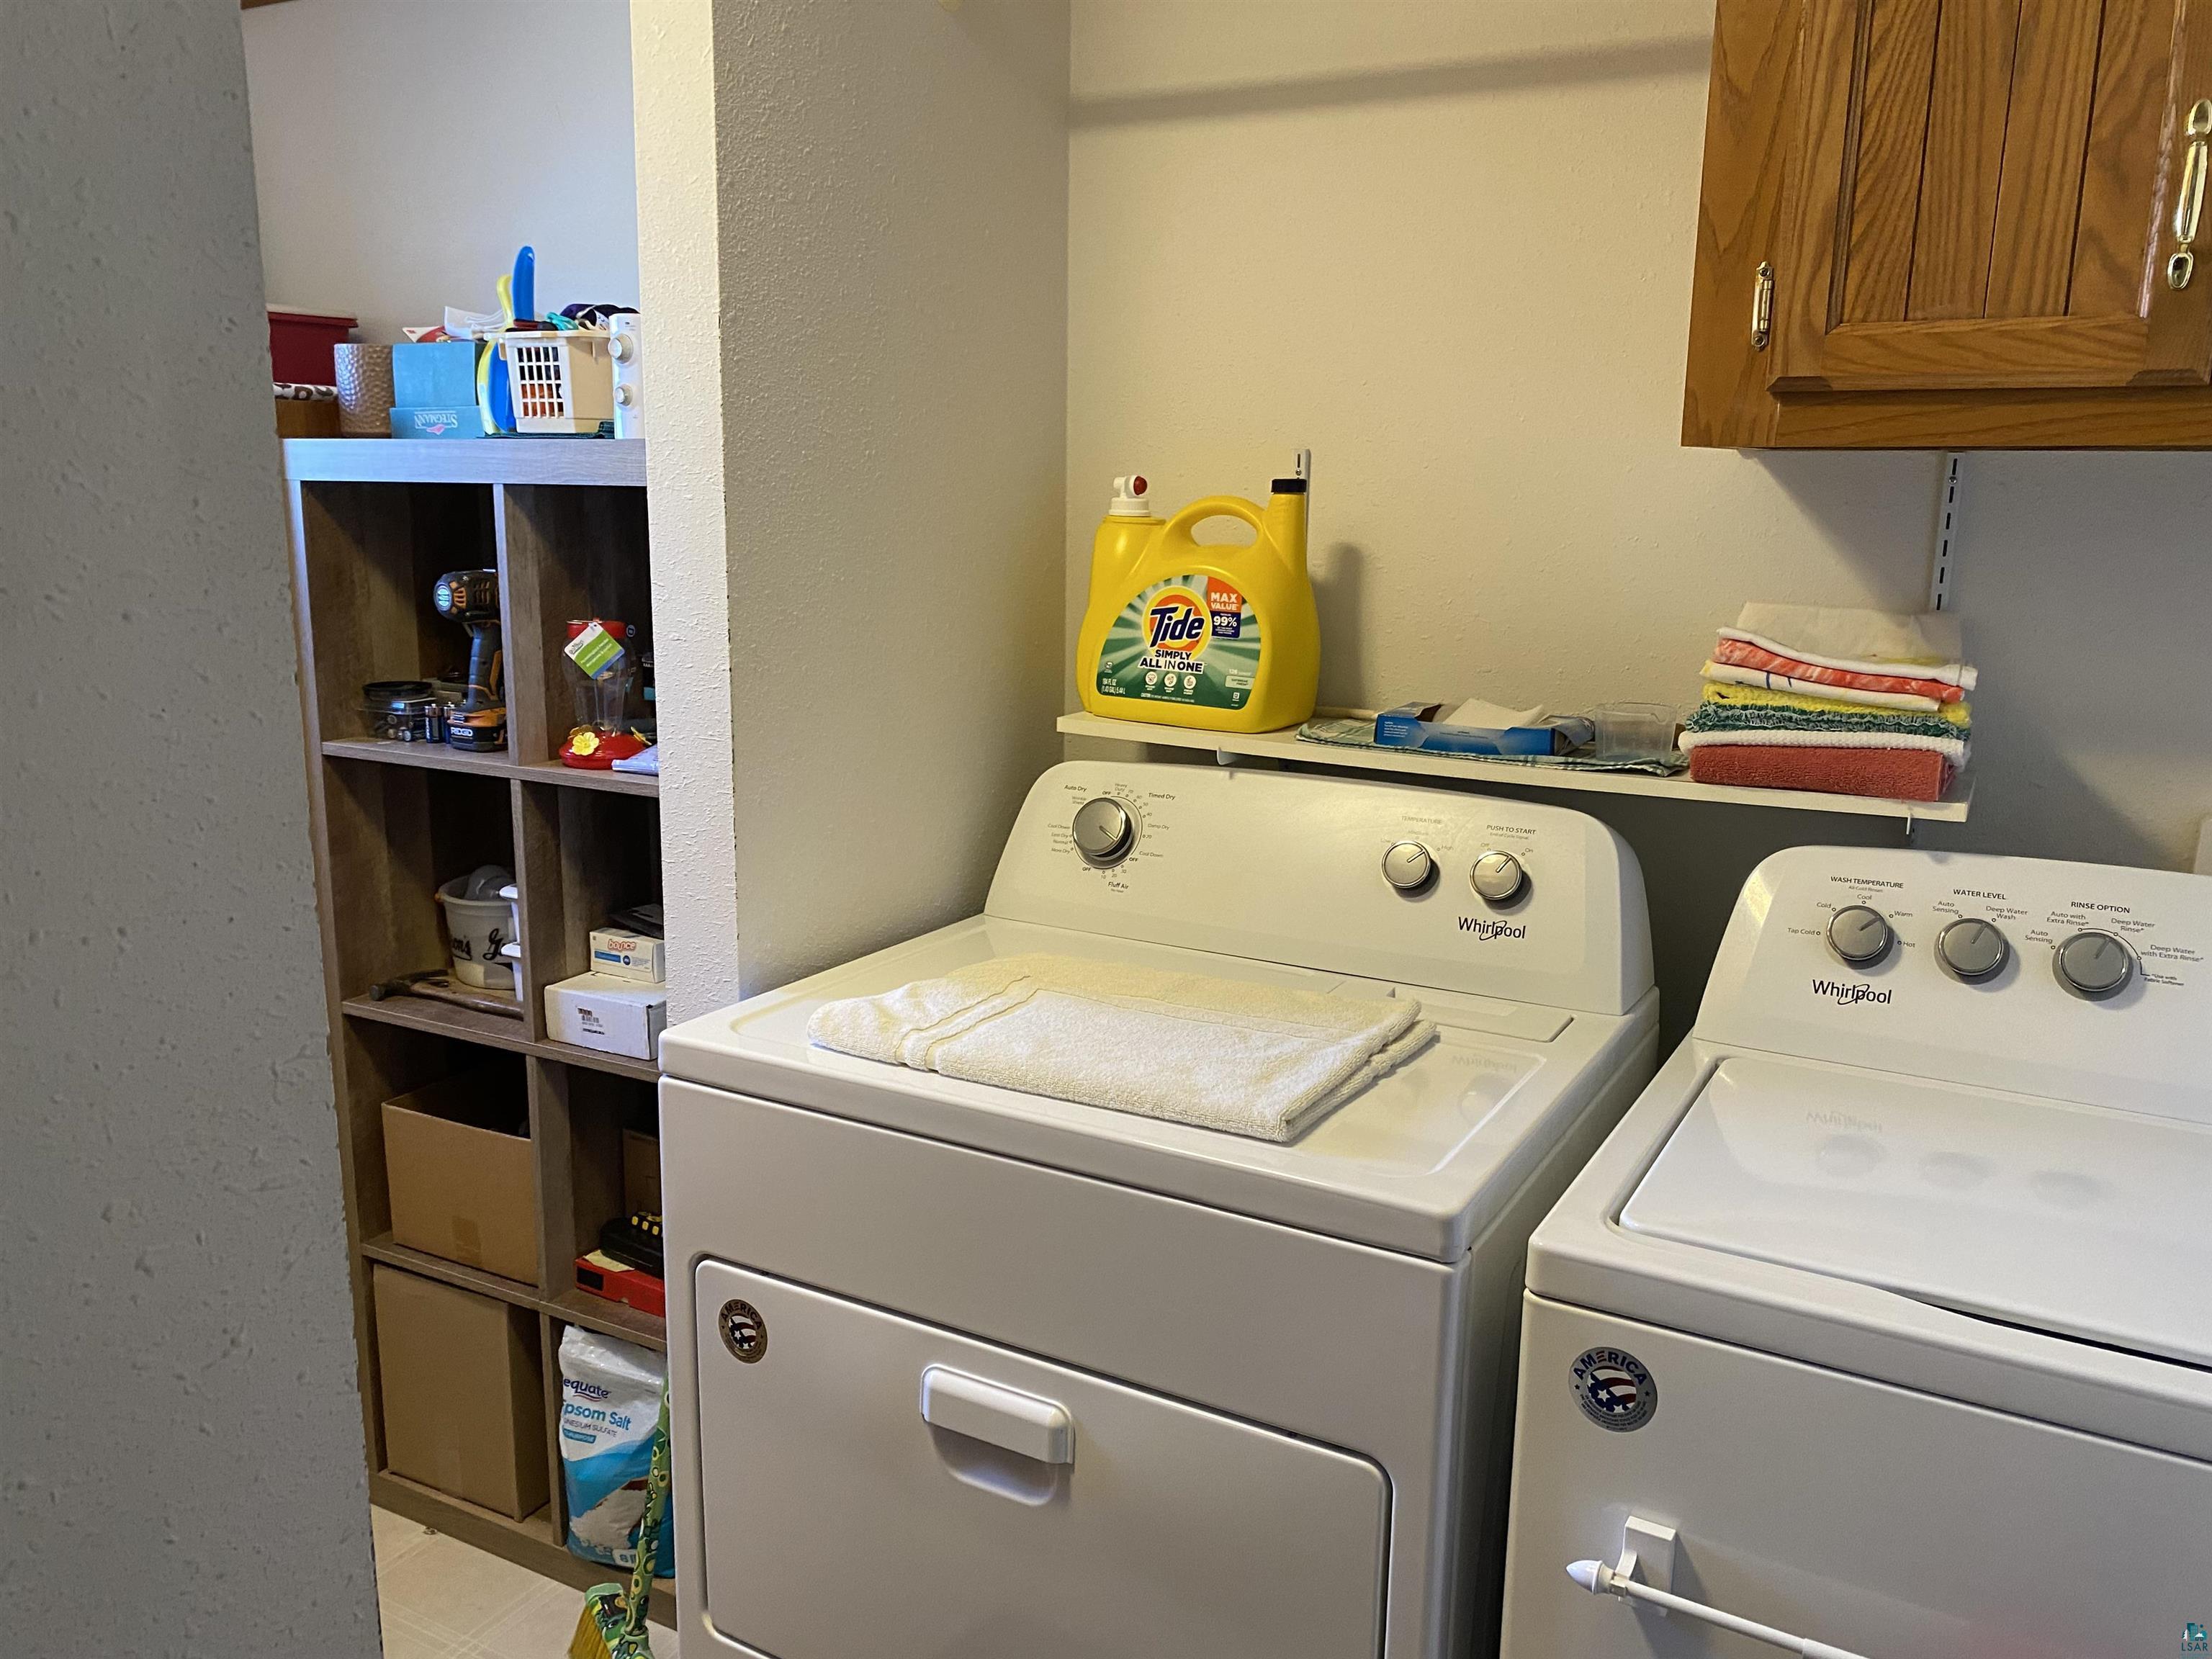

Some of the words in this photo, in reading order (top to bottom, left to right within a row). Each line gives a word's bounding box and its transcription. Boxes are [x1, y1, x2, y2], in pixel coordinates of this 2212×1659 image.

[415, 414, 458, 428] STEGMANN
[1211, 592, 1237, 603] MAX
[1149, 606, 1205, 647] Tide
[1213, 616, 1237, 626] 99%
[1155, 649, 1192, 660] SIMPLY
[1140, 657, 1162, 668] ALL
[1164, 660, 1176, 670] IN
[1177, 661, 1202, 673] ONE
[1401, 816, 1442, 824] TEMPERATURE
[1853, 878, 1904, 889] TEMPERATURE
[1953, 889, 1980, 897] WATER
[2097, 904, 2130, 913] OPTION
[1459, 917, 1526, 940] Whirlpool
[608, 939, 637, 952] bounce
[2025, 935, 2053, 944] Sensing
[1812, 979, 1892, 1005] Whirlpool
[721, 1302, 762, 1329] AMERICA
[1573, 1351, 1647, 1385] AMERICA
[563, 1378, 609, 1398] equate
[563, 1400, 606, 1421] psom
[609, 1411, 631, 1430] Salt
